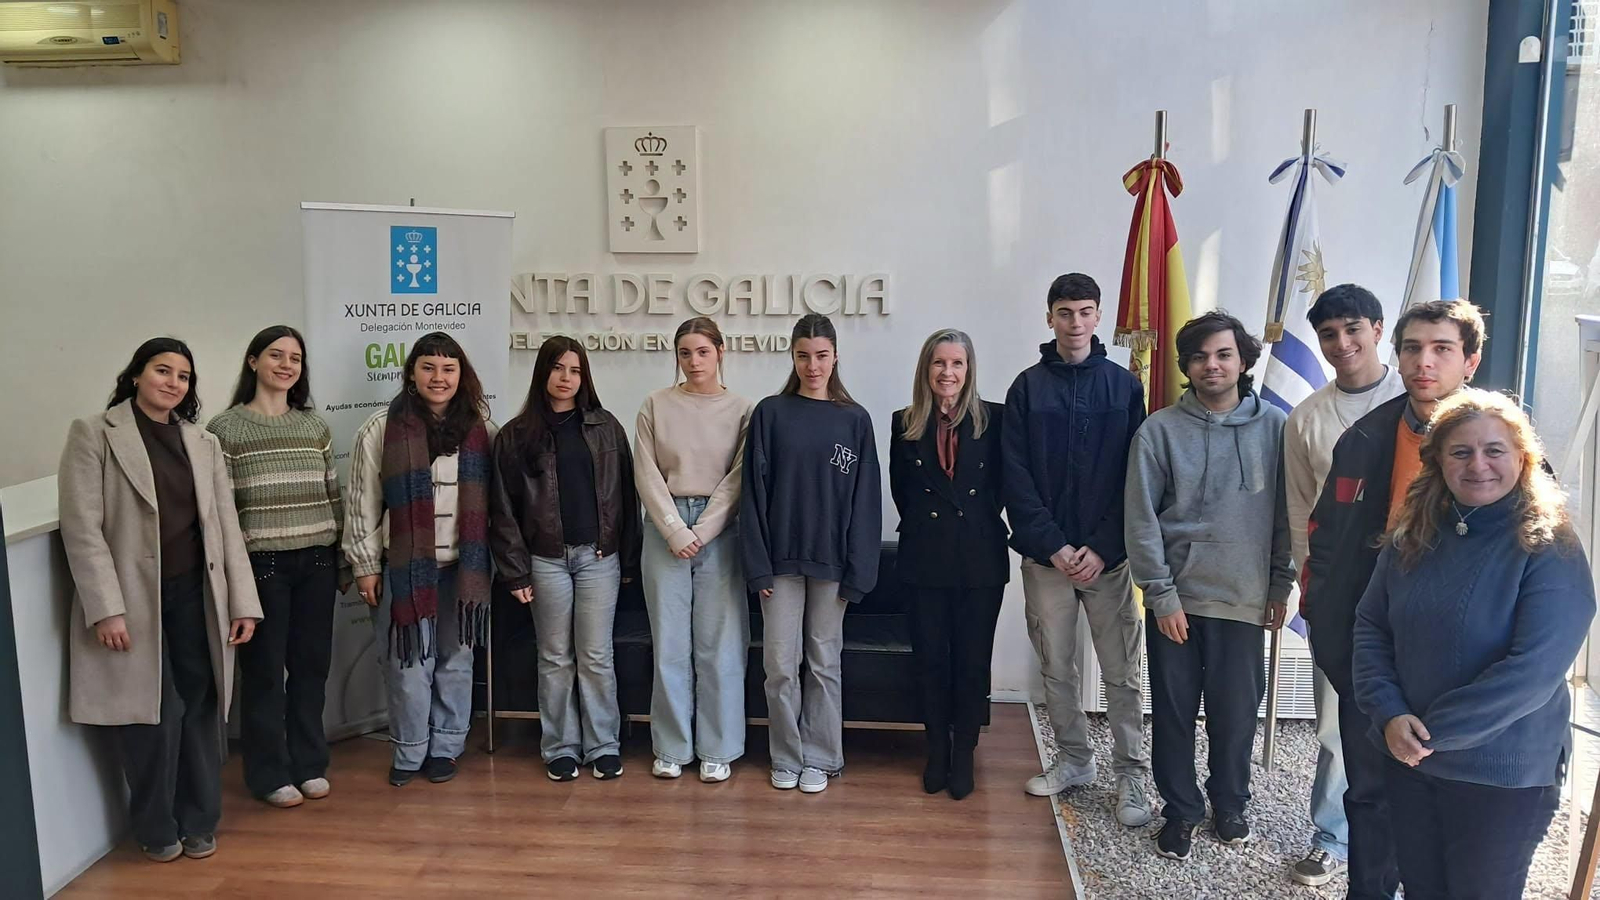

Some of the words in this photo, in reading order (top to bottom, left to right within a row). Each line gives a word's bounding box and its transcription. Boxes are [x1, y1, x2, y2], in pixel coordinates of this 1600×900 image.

[510, 272, 597, 315] NTA
[614, 272, 675, 316] DE
[687, 273, 891, 317] GALICIA
[344, 303, 396, 318] XUNTA
[401, 303, 420, 317] DE
[423, 302, 481, 316] GALICIA
[360, 323, 413, 333] Delegación
[415, 321, 466, 331] Montevideo
[643, 333, 674, 352] EN
[365, 342, 406, 369] GAL
[367, 371, 404, 382] Siempr
[325, 402, 352, 412] Ayudas
[354, 400, 391, 409] económic
[830, 443, 857, 474] NY
